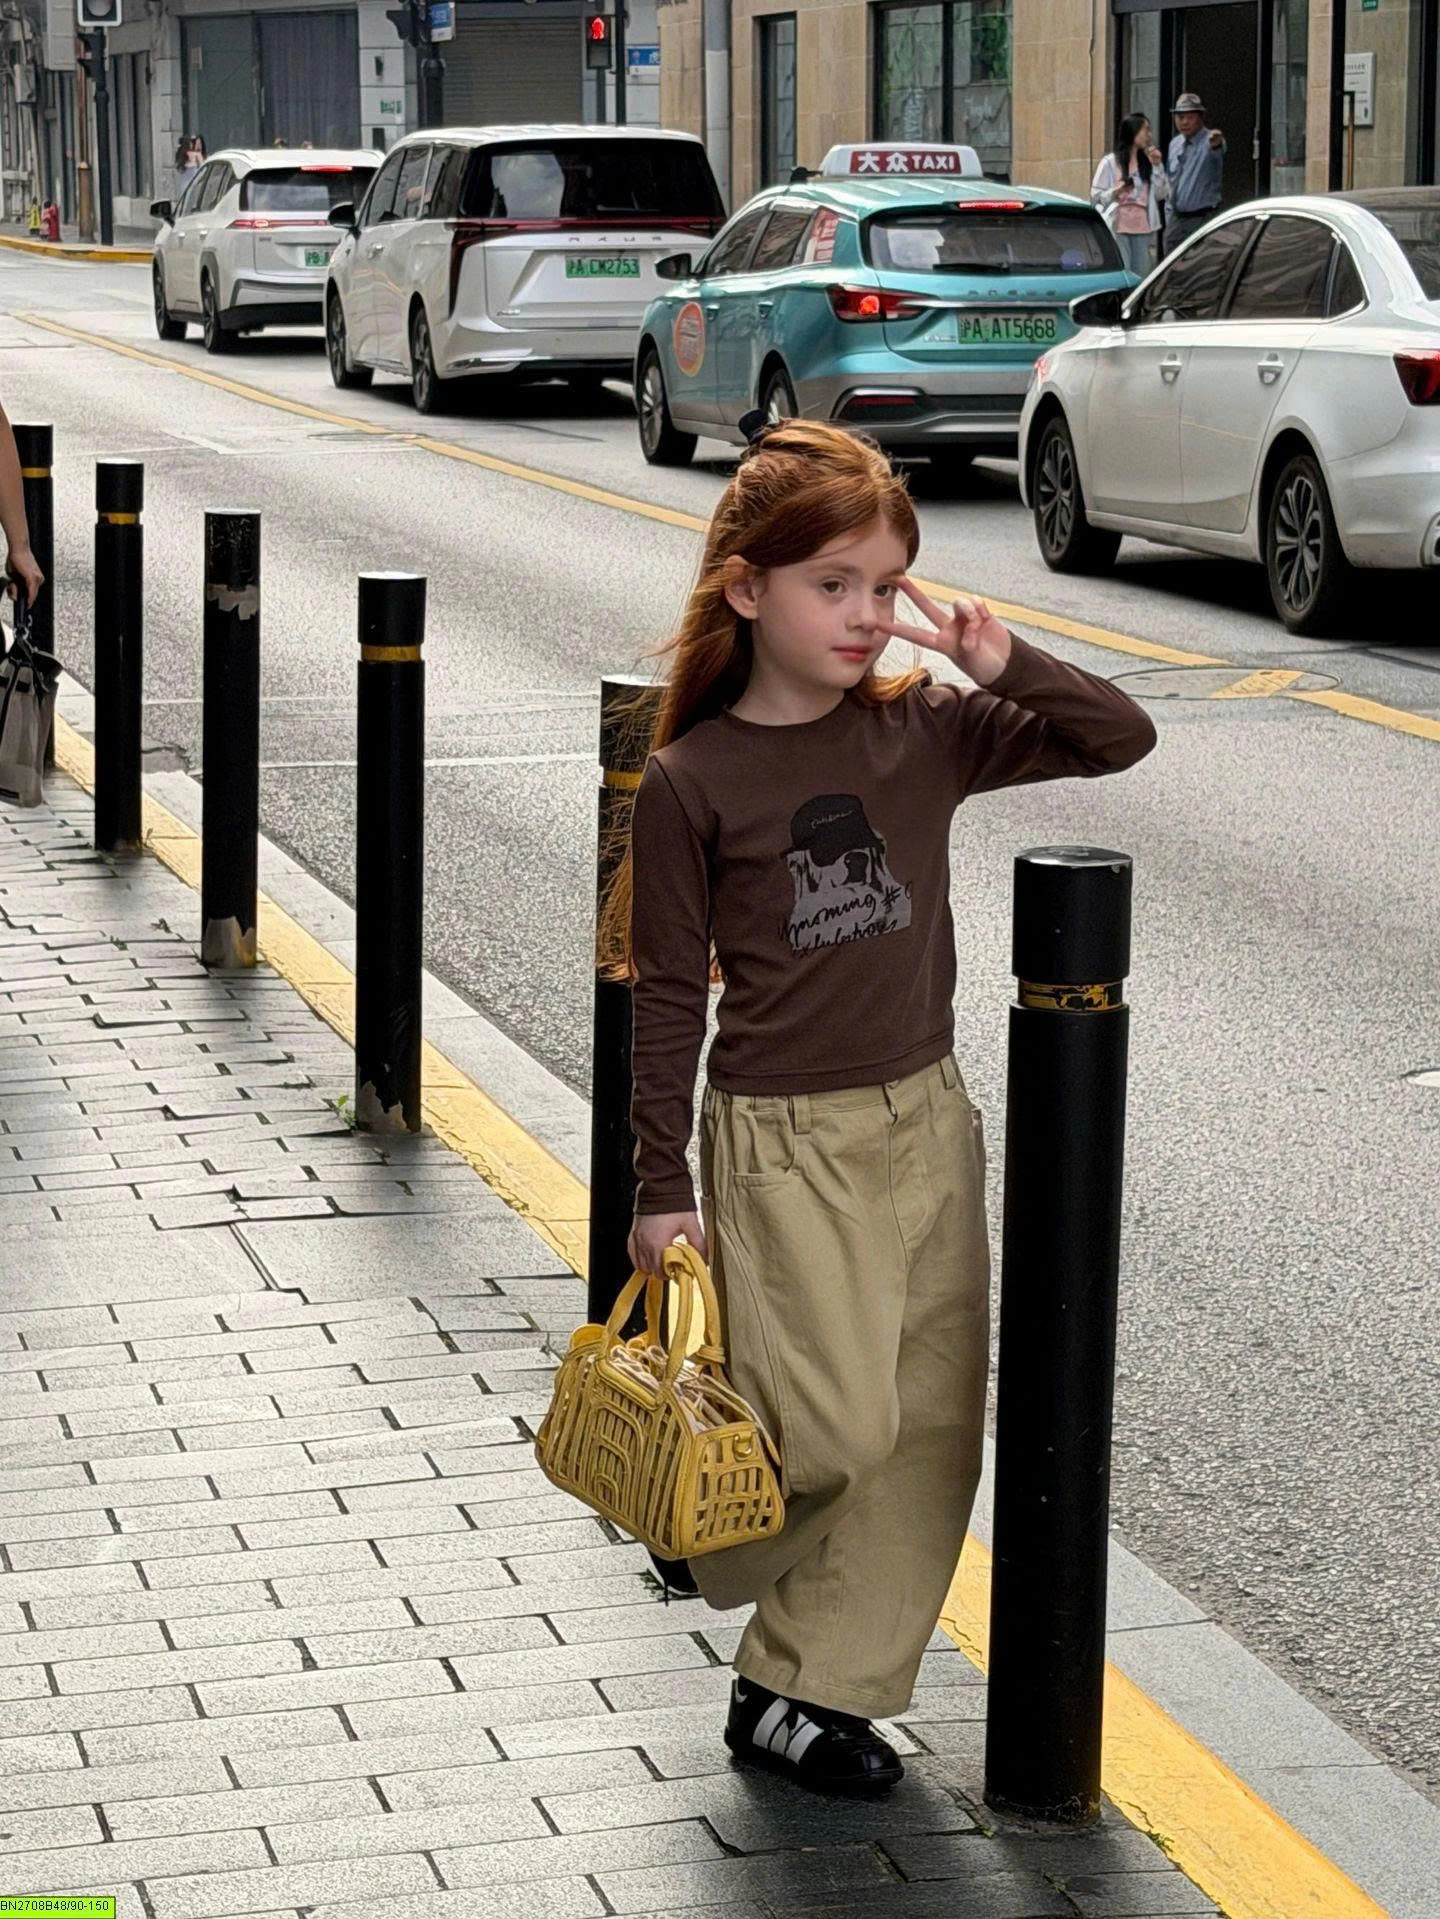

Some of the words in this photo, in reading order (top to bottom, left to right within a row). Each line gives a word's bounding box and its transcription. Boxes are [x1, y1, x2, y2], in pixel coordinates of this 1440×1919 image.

[858, 152, 909, 172] 大众
[912, 156, 954, 170] TAXI
[992, 317, 1056, 340] AT5668
